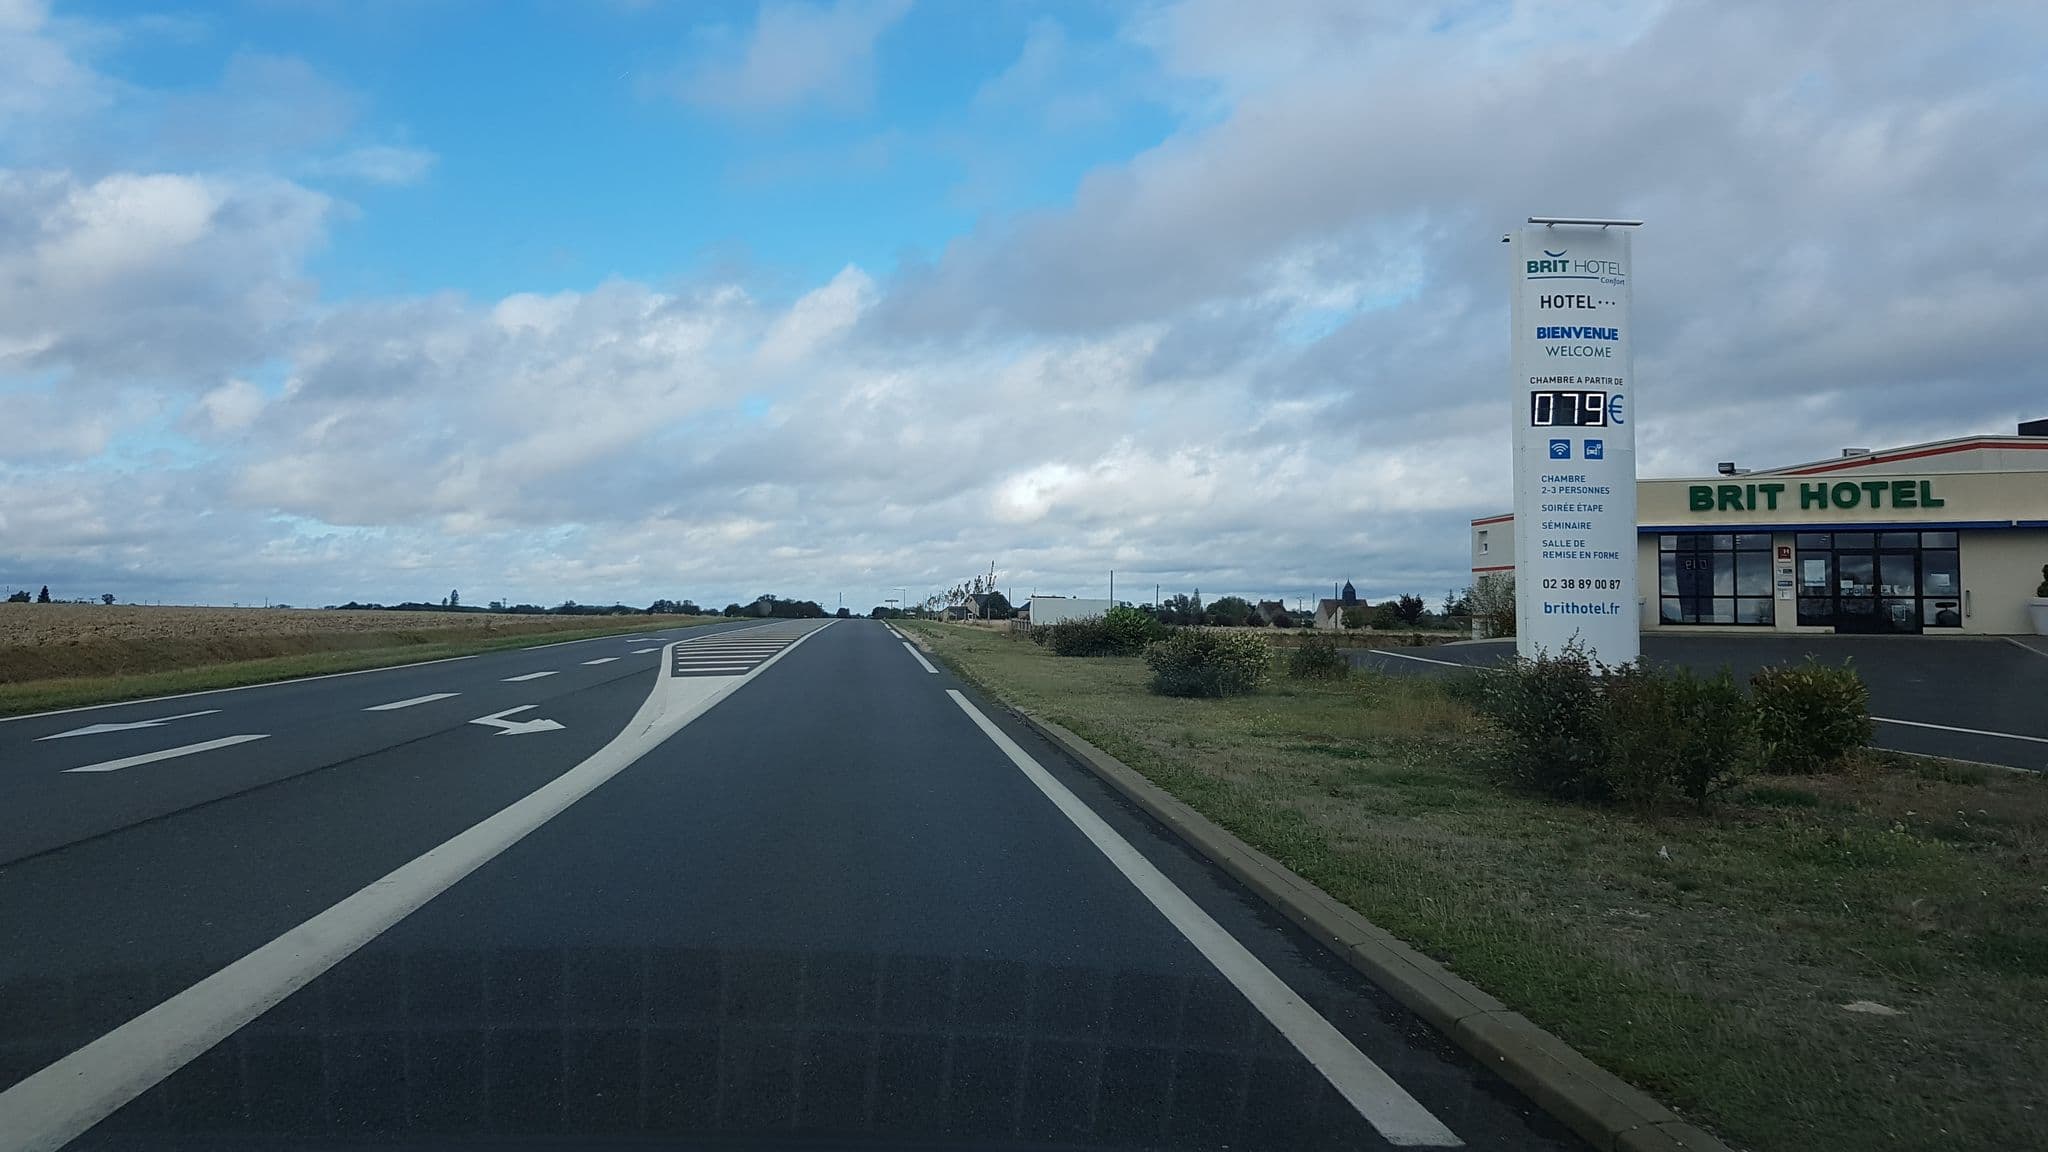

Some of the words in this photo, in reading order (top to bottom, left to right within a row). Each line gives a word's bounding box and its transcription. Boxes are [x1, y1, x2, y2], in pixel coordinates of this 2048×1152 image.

[1527, 260, 1569, 273] BRIT
[1574, 260, 1625, 276] HOTEL
[1600, 277, 1625, 286] Confort
[1536, 327, 1619, 340] BIENVENUE
[1546, 346, 1612, 358] WELCOME
[1530, 376, 1574, 385] CHAMBRE
[1585, 376, 1612, 385] PARTIR
[1615, 378, 1623, 386] DE
[1541, 475, 1586, 483] CHAMBRE
[1559, 486, 1610, 495] PERSONNES
[1689, 484, 1785, 512] BRIT
[1800, 480, 1945, 510] HOTEL
[1541, 502, 1575, 512] SOIRÉE
[1577, 502, 1604, 512] ÉTAPE
[1541, 520, 1592, 530] SÉMINAIRE
[1542, 539, 1571, 548] SALLE
[1574, 539, 1585, 548] DE
[1543, 551, 1577, 559] REMISE
[1579, 551, 1591, 559] EN
[1593, 551, 1619, 560] FORME
[1543, 579, 1557, 589] 02
[1560, 579, 1574, 589] 38
[1578, 579, 1591, 590] 89
[1594, 579, 1607, 590] 00
[1609, 579, 1621, 590] 87
[1544, 602, 1620, 615] brithotel.fr
